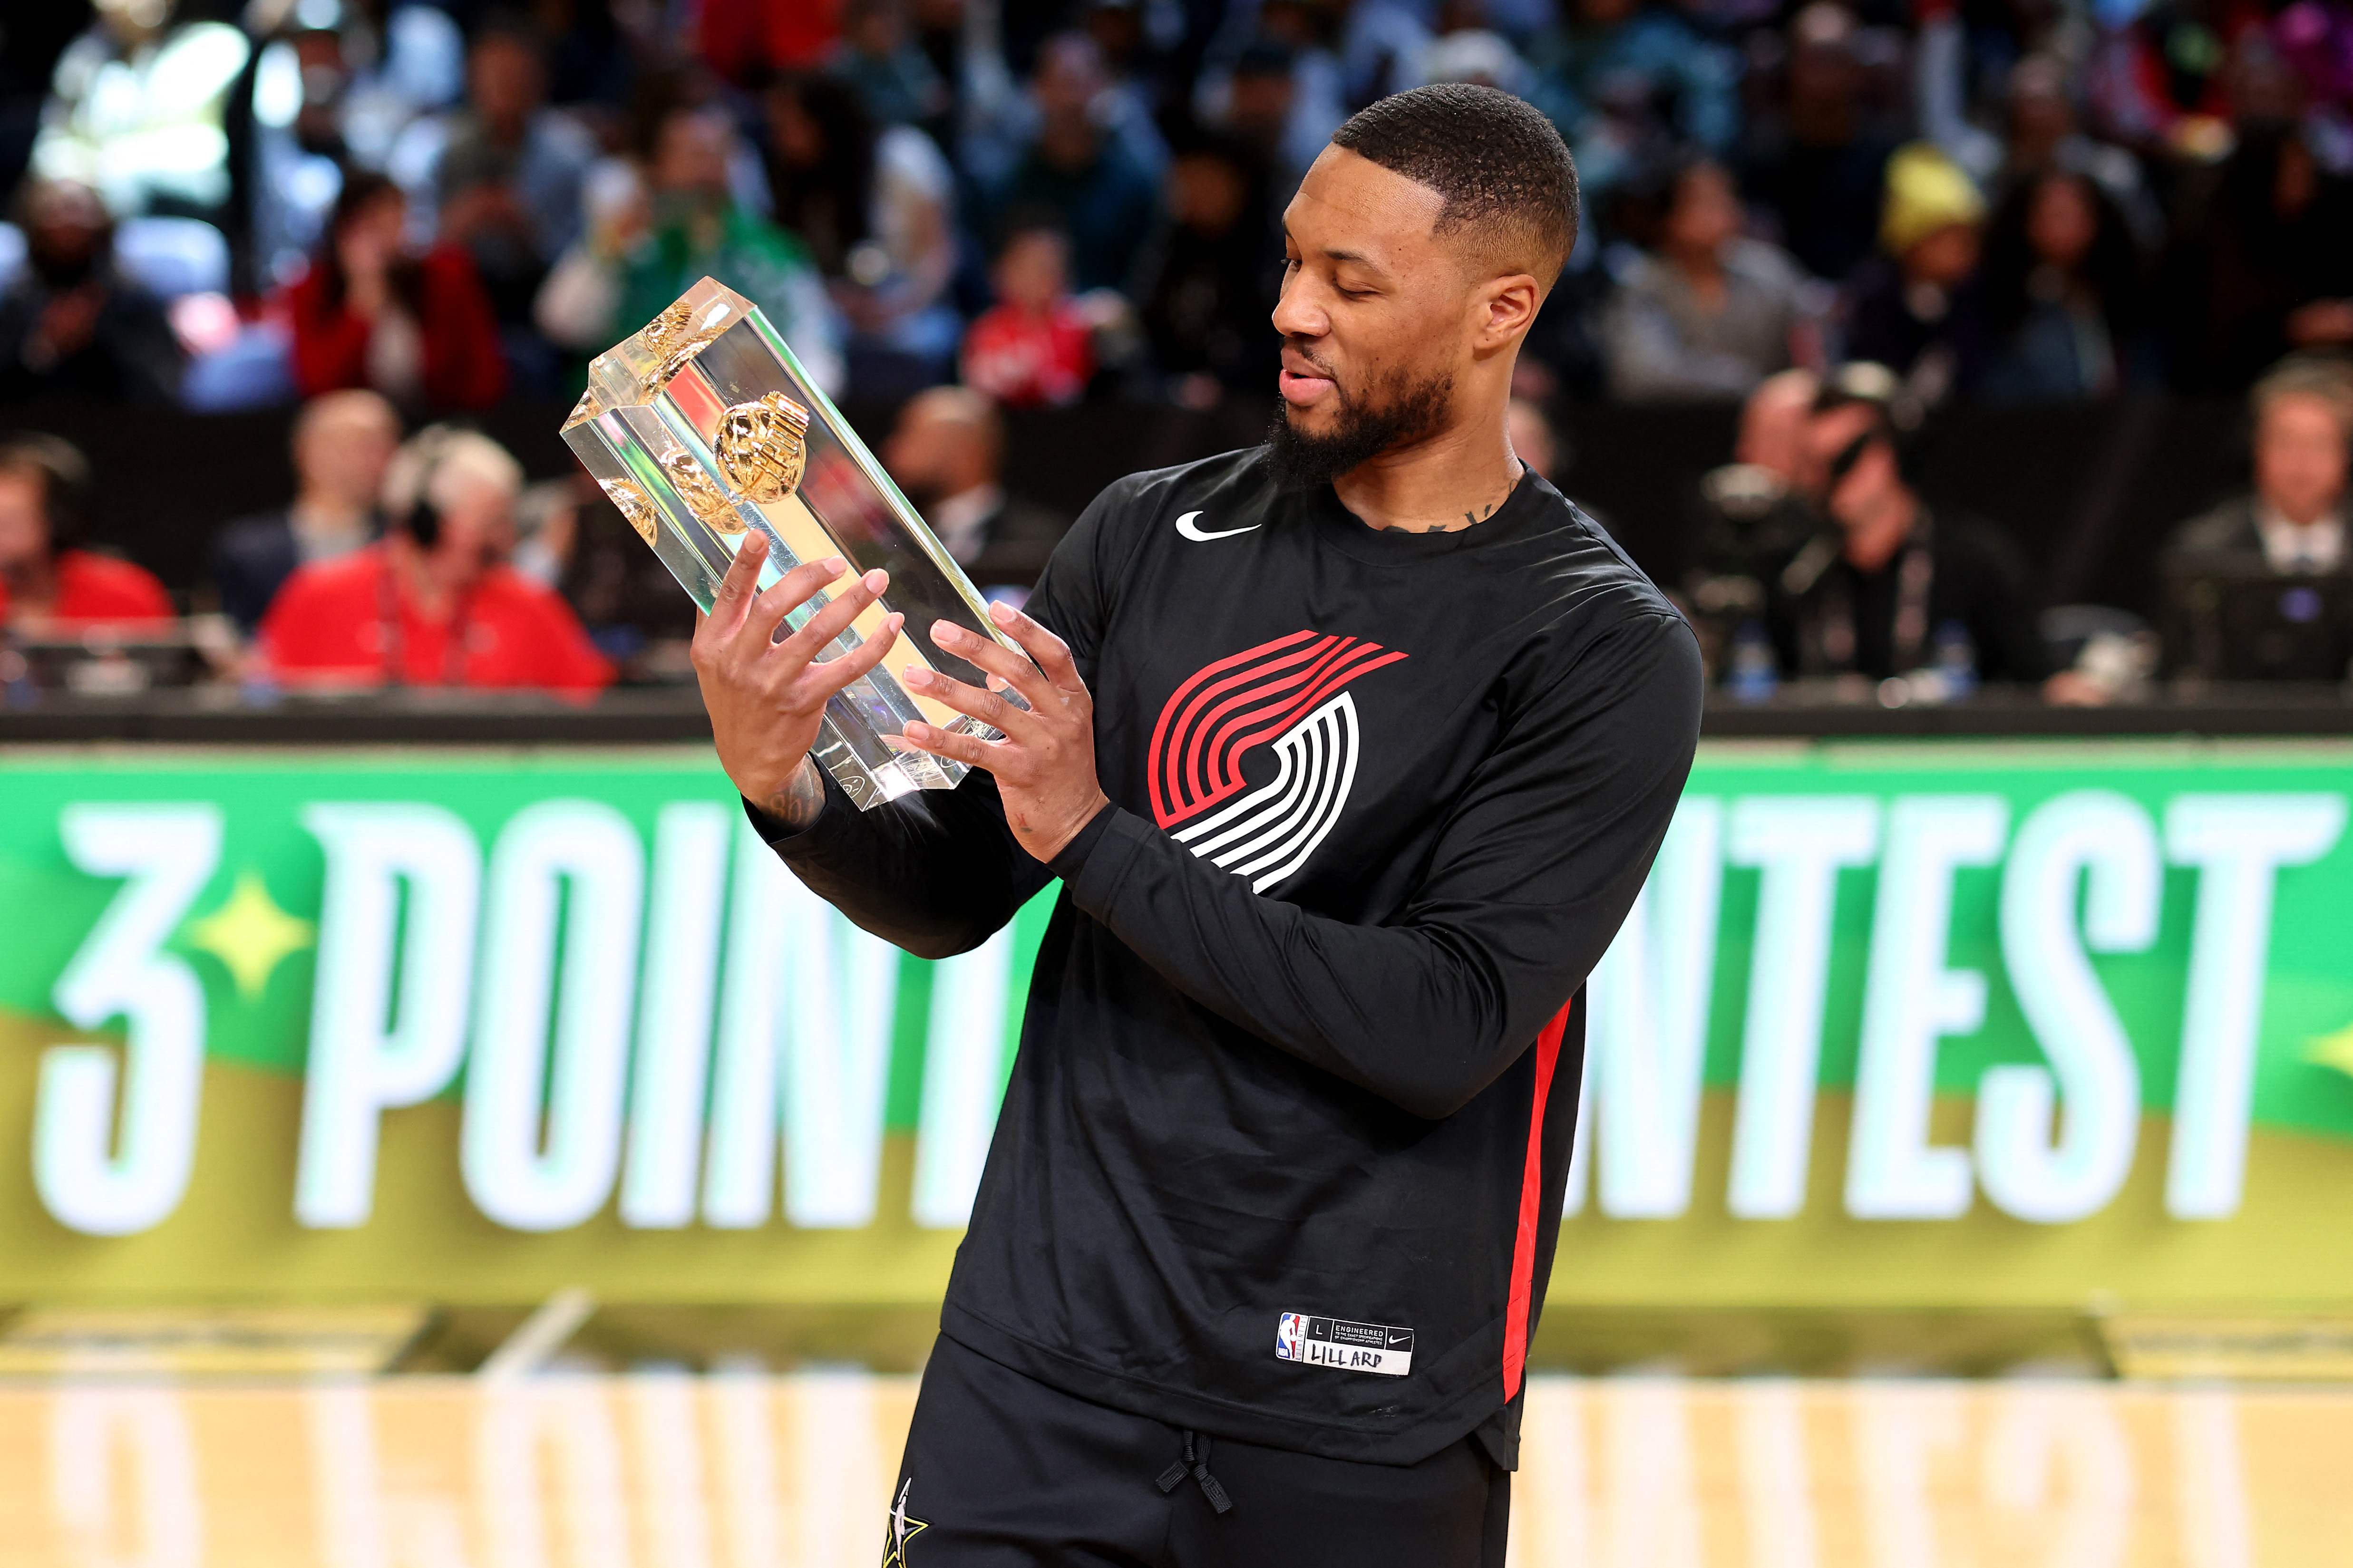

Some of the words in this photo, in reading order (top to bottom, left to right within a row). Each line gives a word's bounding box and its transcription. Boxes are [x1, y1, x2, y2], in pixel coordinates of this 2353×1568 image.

[31, 801, 225, 1236] 3
[1560, 787, 2348, 1225] NTEST
[1315, 1324, 1323, 1335] L
[1335, 1325, 1383, 1337] ENGINEERED
